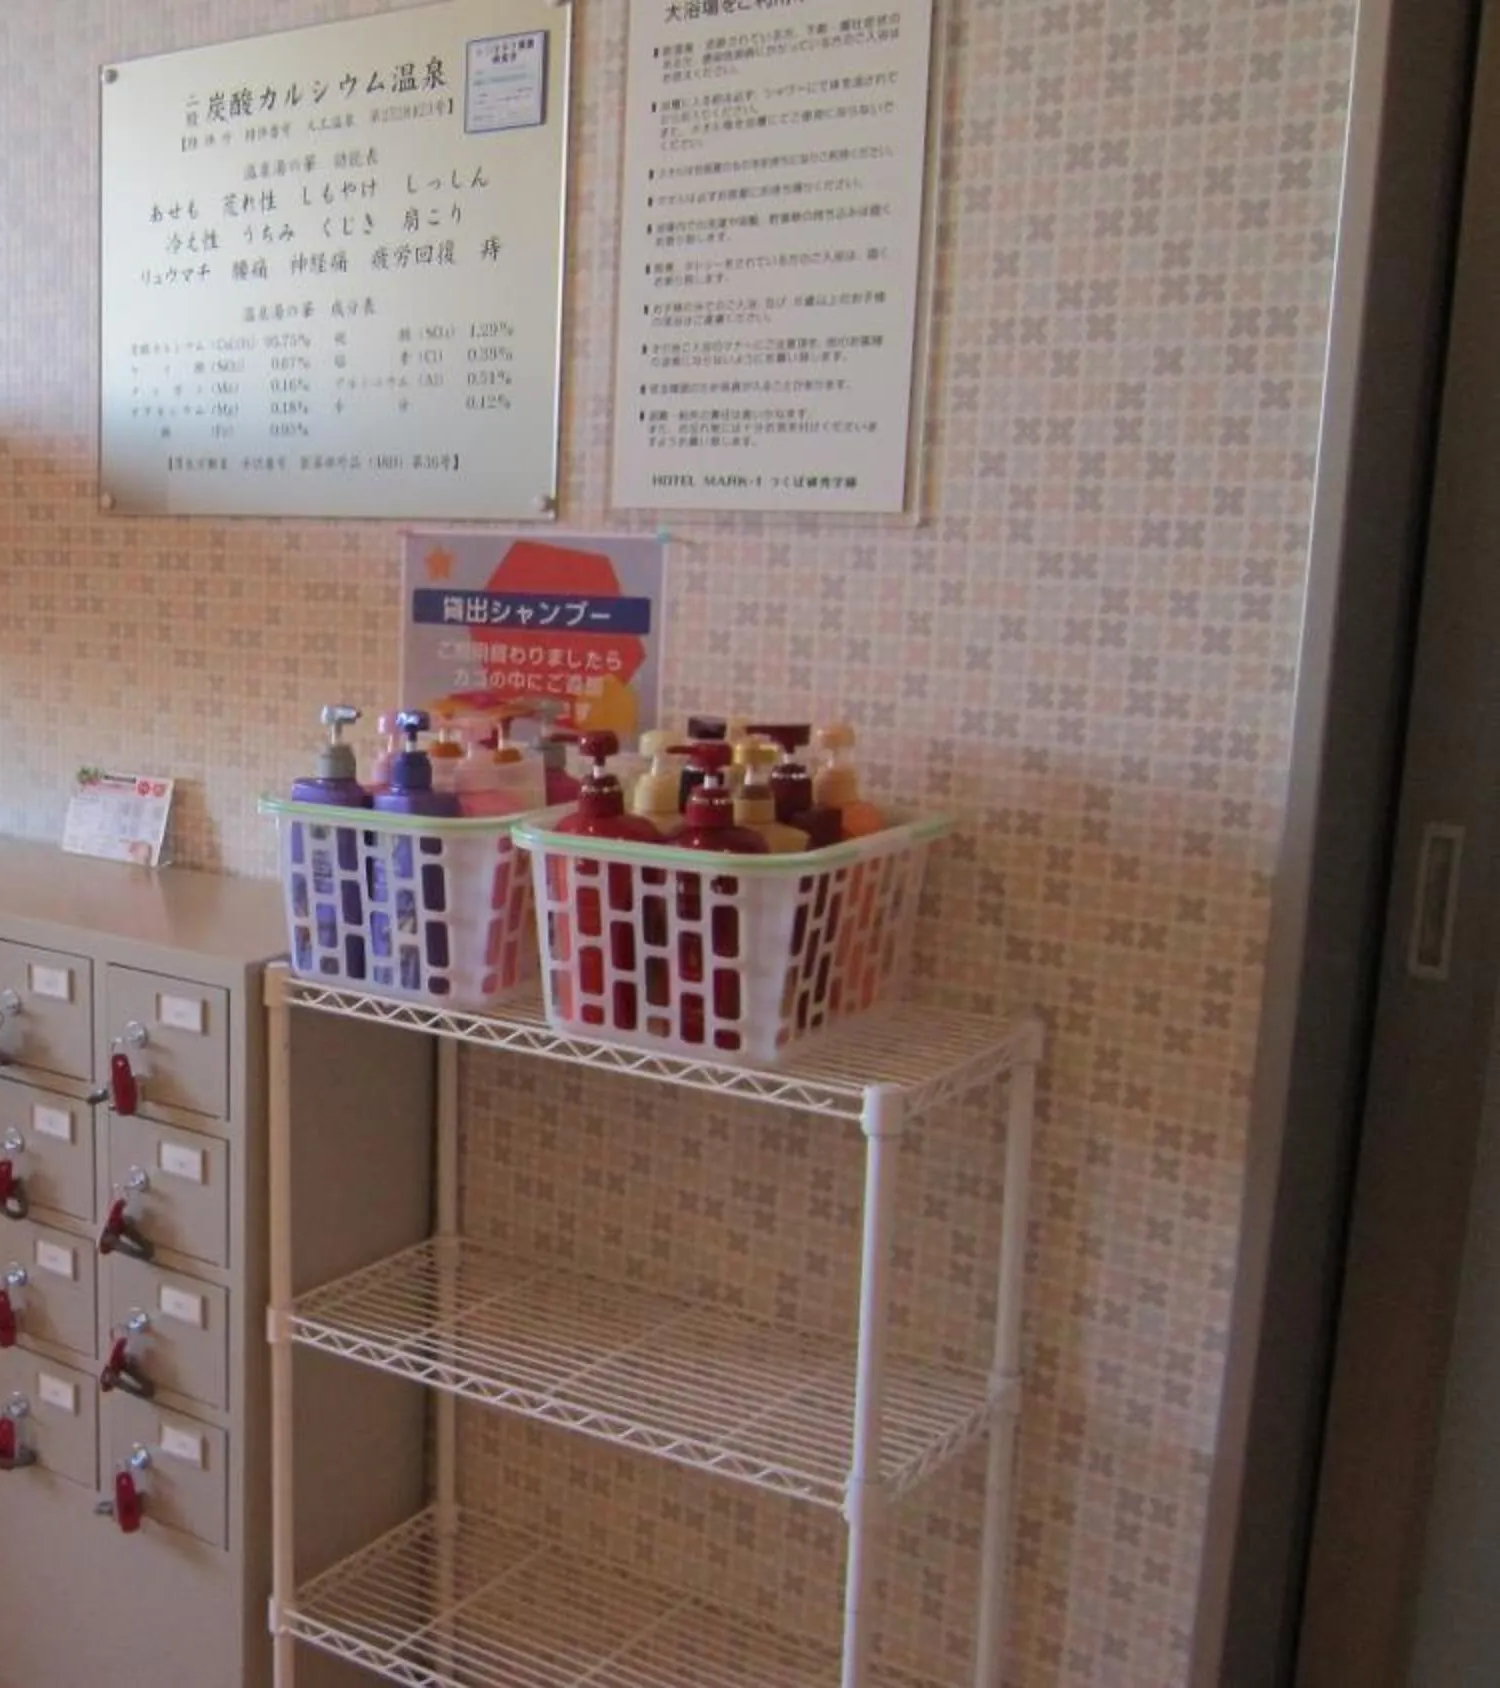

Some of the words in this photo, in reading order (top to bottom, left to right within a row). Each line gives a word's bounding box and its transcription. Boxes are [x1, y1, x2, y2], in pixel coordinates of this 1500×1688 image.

[206, 56, 448, 122] 炭酸カルシウム温泉
[150, 198, 199, 225] あせも
[301, 177, 378, 208] しもやけ
[406, 165, 489, 196] しっしん
[243, 219, 296, 243] うちみ
[322, 212, 376, 238] くじき
[402, 204, 463, 232] 肩こり
[140, 263, 211, 286] リュウマチ
[372, 238, 457, 271] 疲労回復
[652, 475, 694, 488] HOTEL
